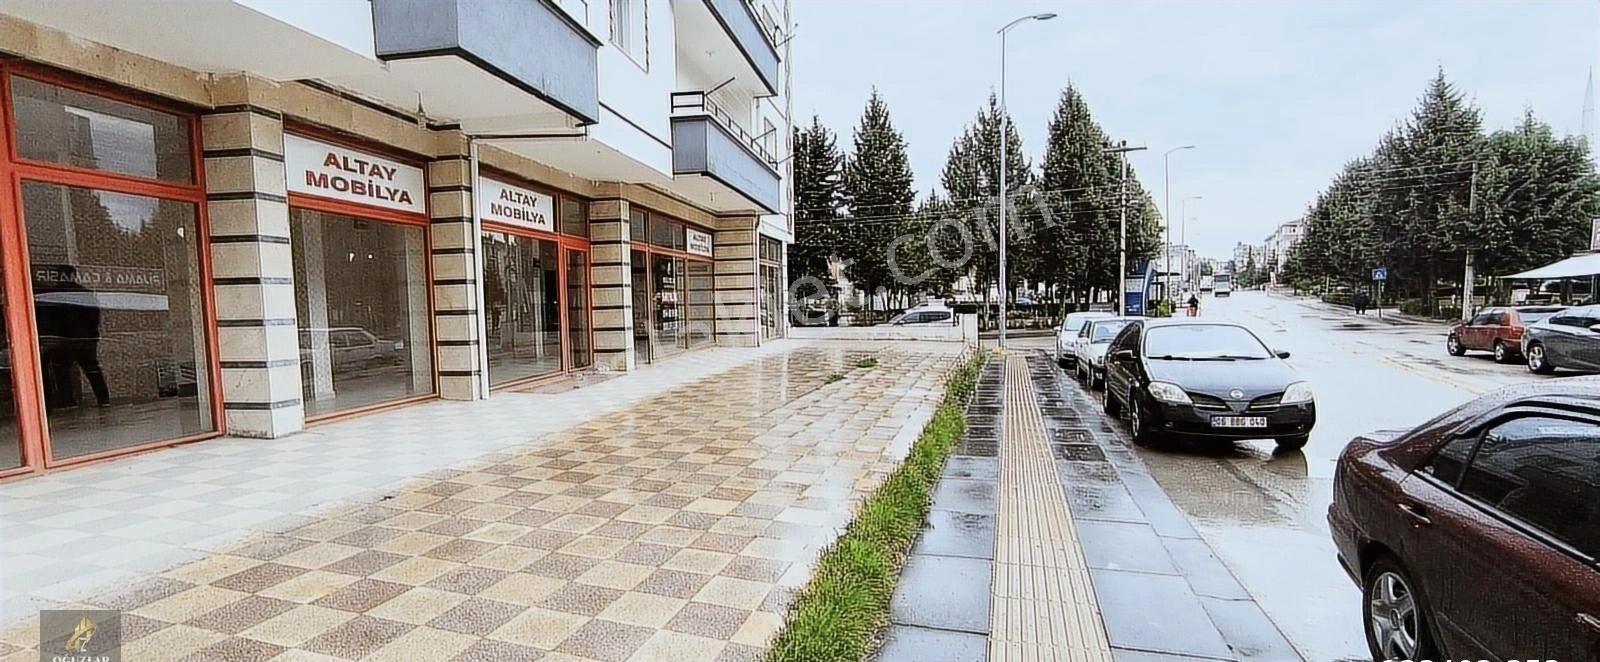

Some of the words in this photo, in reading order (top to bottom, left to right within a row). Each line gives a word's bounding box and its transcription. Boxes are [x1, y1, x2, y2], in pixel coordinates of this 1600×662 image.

[323, 152, 397, 181] ALTAY
[305, 169, 413, 205] MOBİLYA
[500, 188, 538, 208] ALTAY
[490, 202, 546, 225] MOBİLYA
